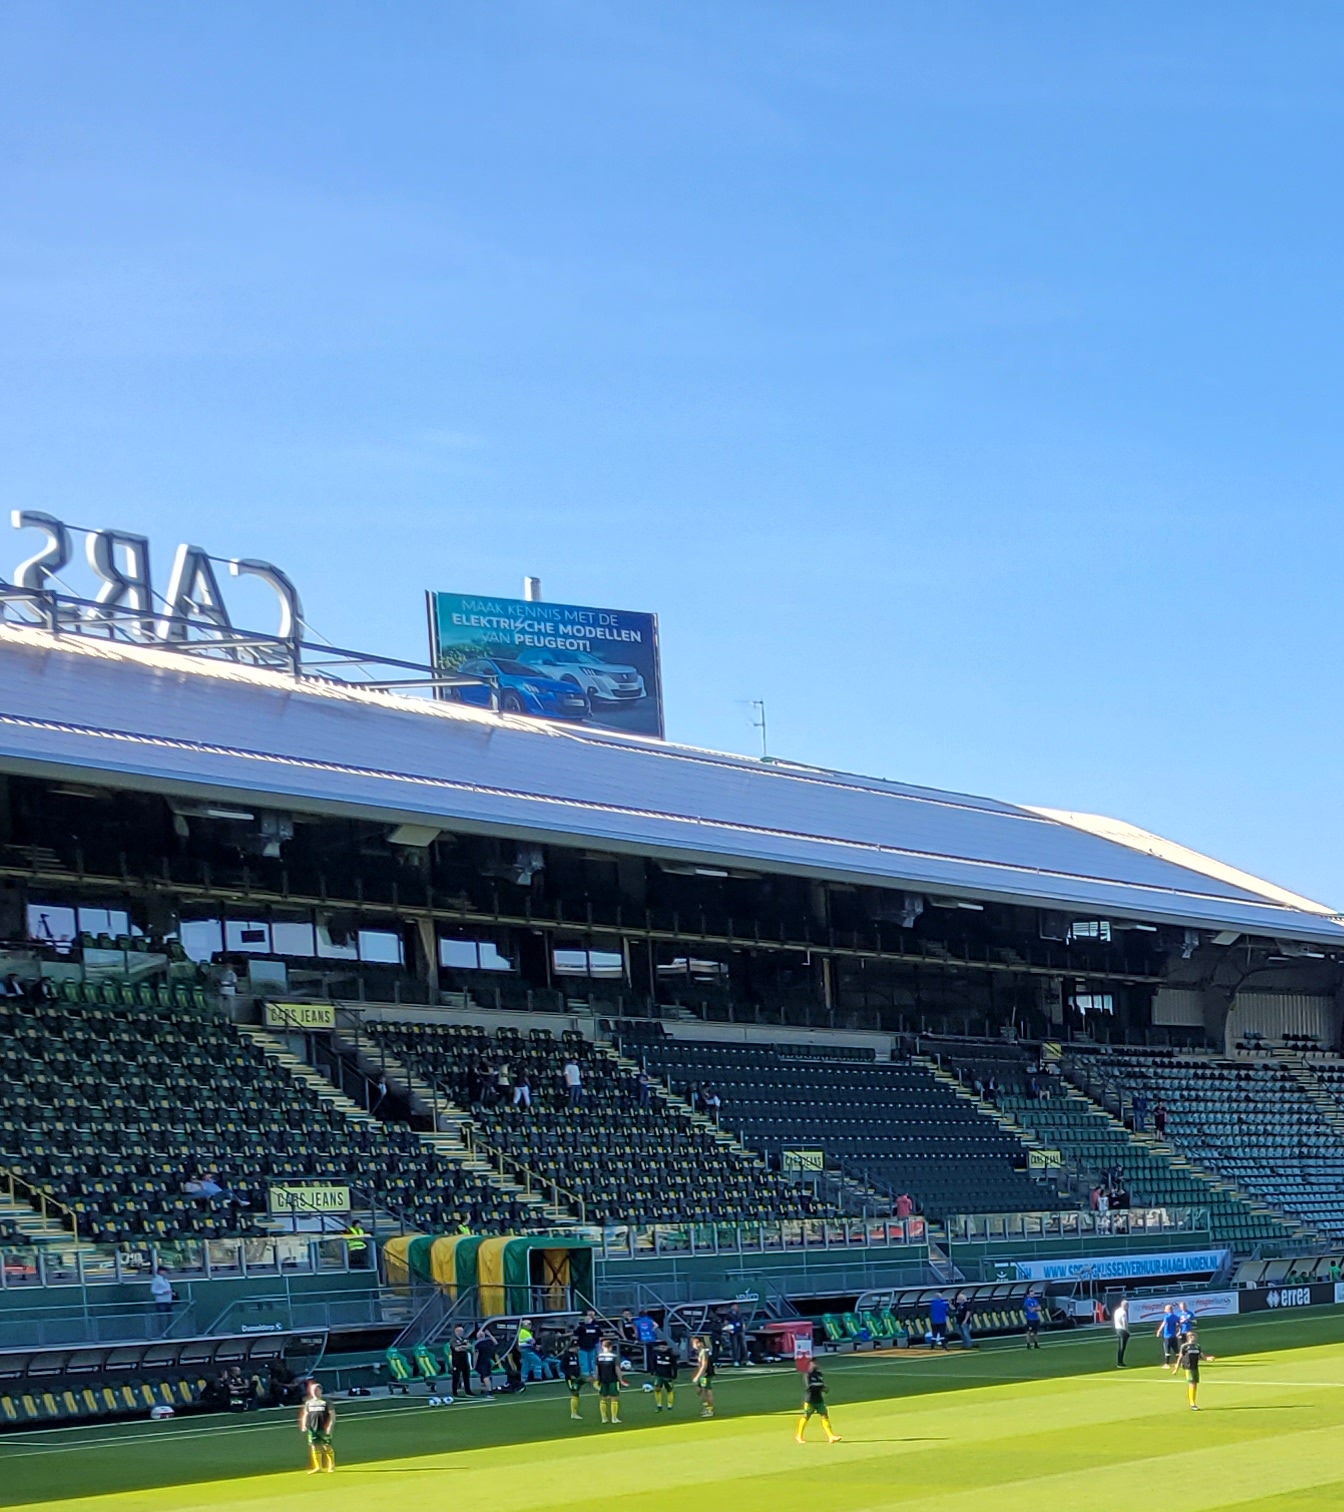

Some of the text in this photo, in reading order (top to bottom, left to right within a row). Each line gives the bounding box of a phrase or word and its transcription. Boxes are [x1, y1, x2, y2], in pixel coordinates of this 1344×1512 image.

[462, 601, 618, 626] MAAK KENNIS MET DE
[452, 613, 642, 643] ELEKTRISCHE MODELLEN
[482, 630, 591, 652] VAN PEUGEOT!
[271, 1008, 331, 1023] CARS JEANS
[311, 1191, 344, 1207] JEANS
